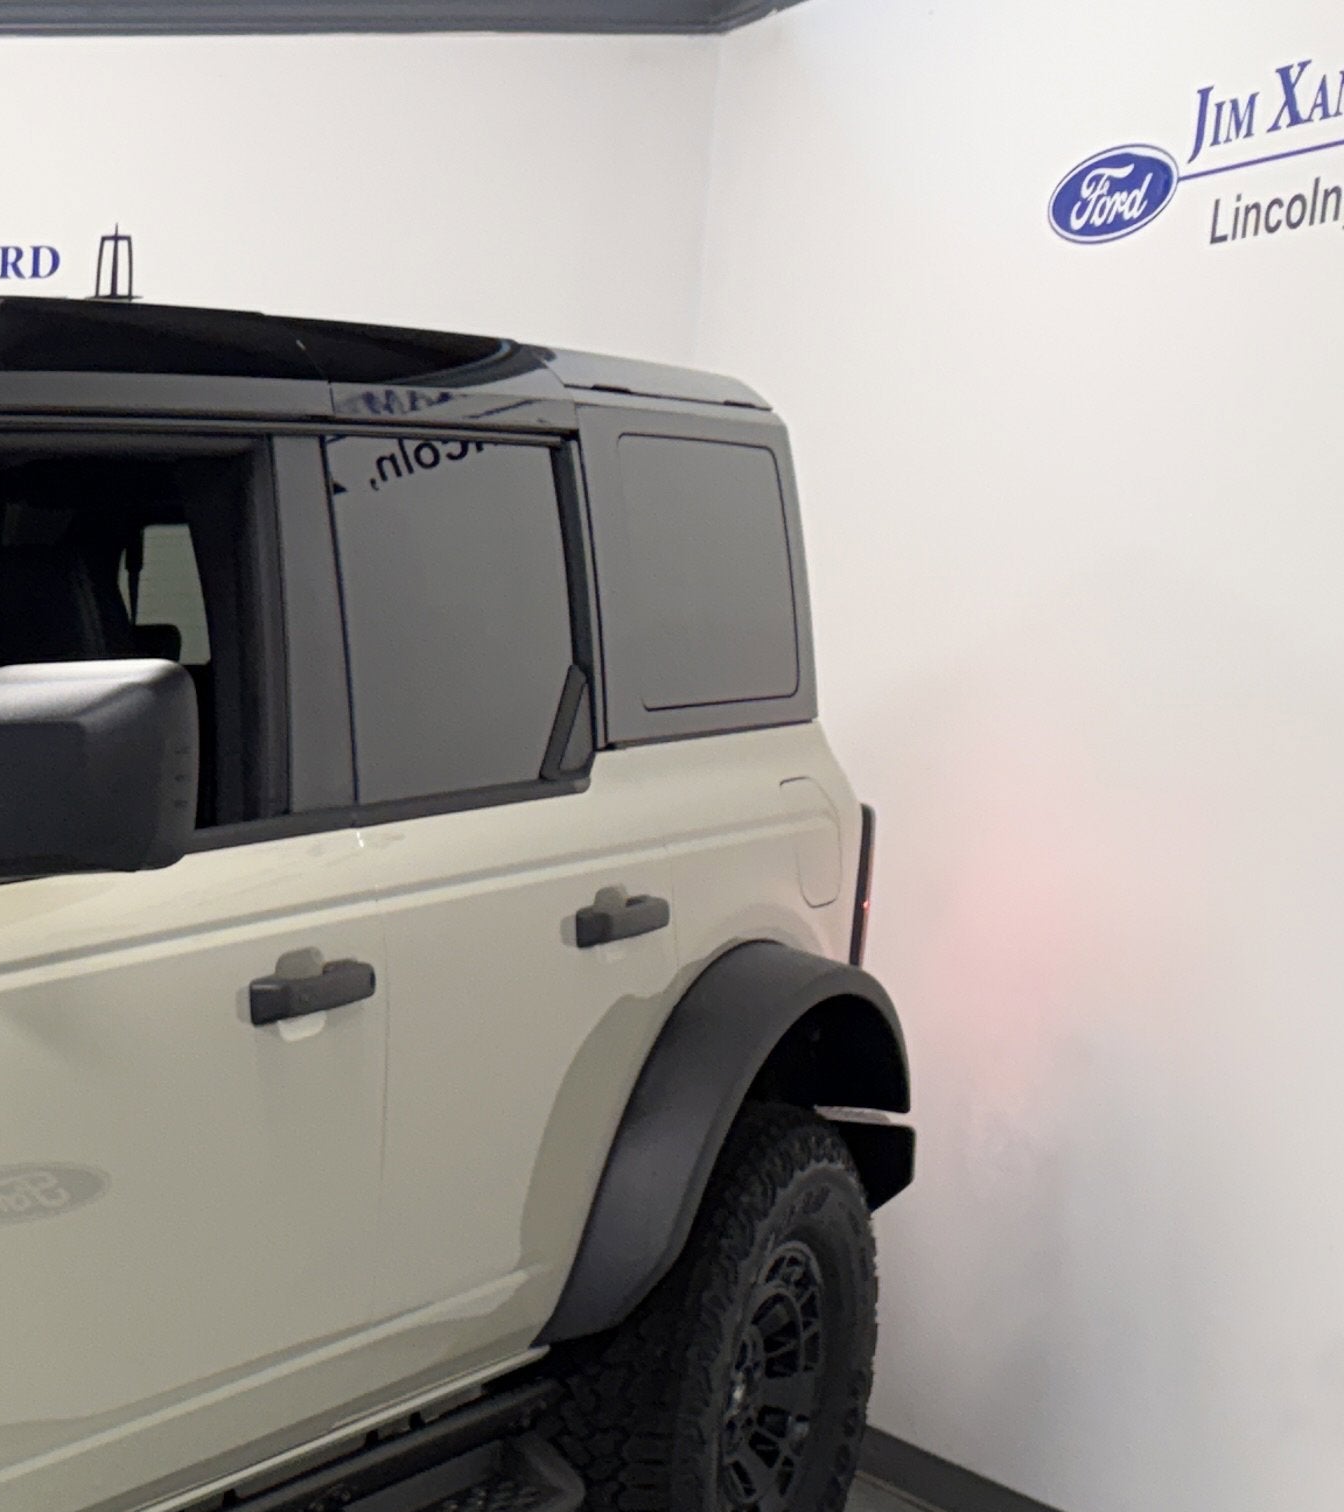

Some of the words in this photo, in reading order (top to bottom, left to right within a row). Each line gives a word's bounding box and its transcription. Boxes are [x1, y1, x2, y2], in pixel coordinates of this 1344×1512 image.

[1187, 85, 1261, 164] JIM
[1266, 58, 1344, 134] XA
[1069, 162, 1154, 231] Ford
[1209, 176, 1344, 245] Lincoln
